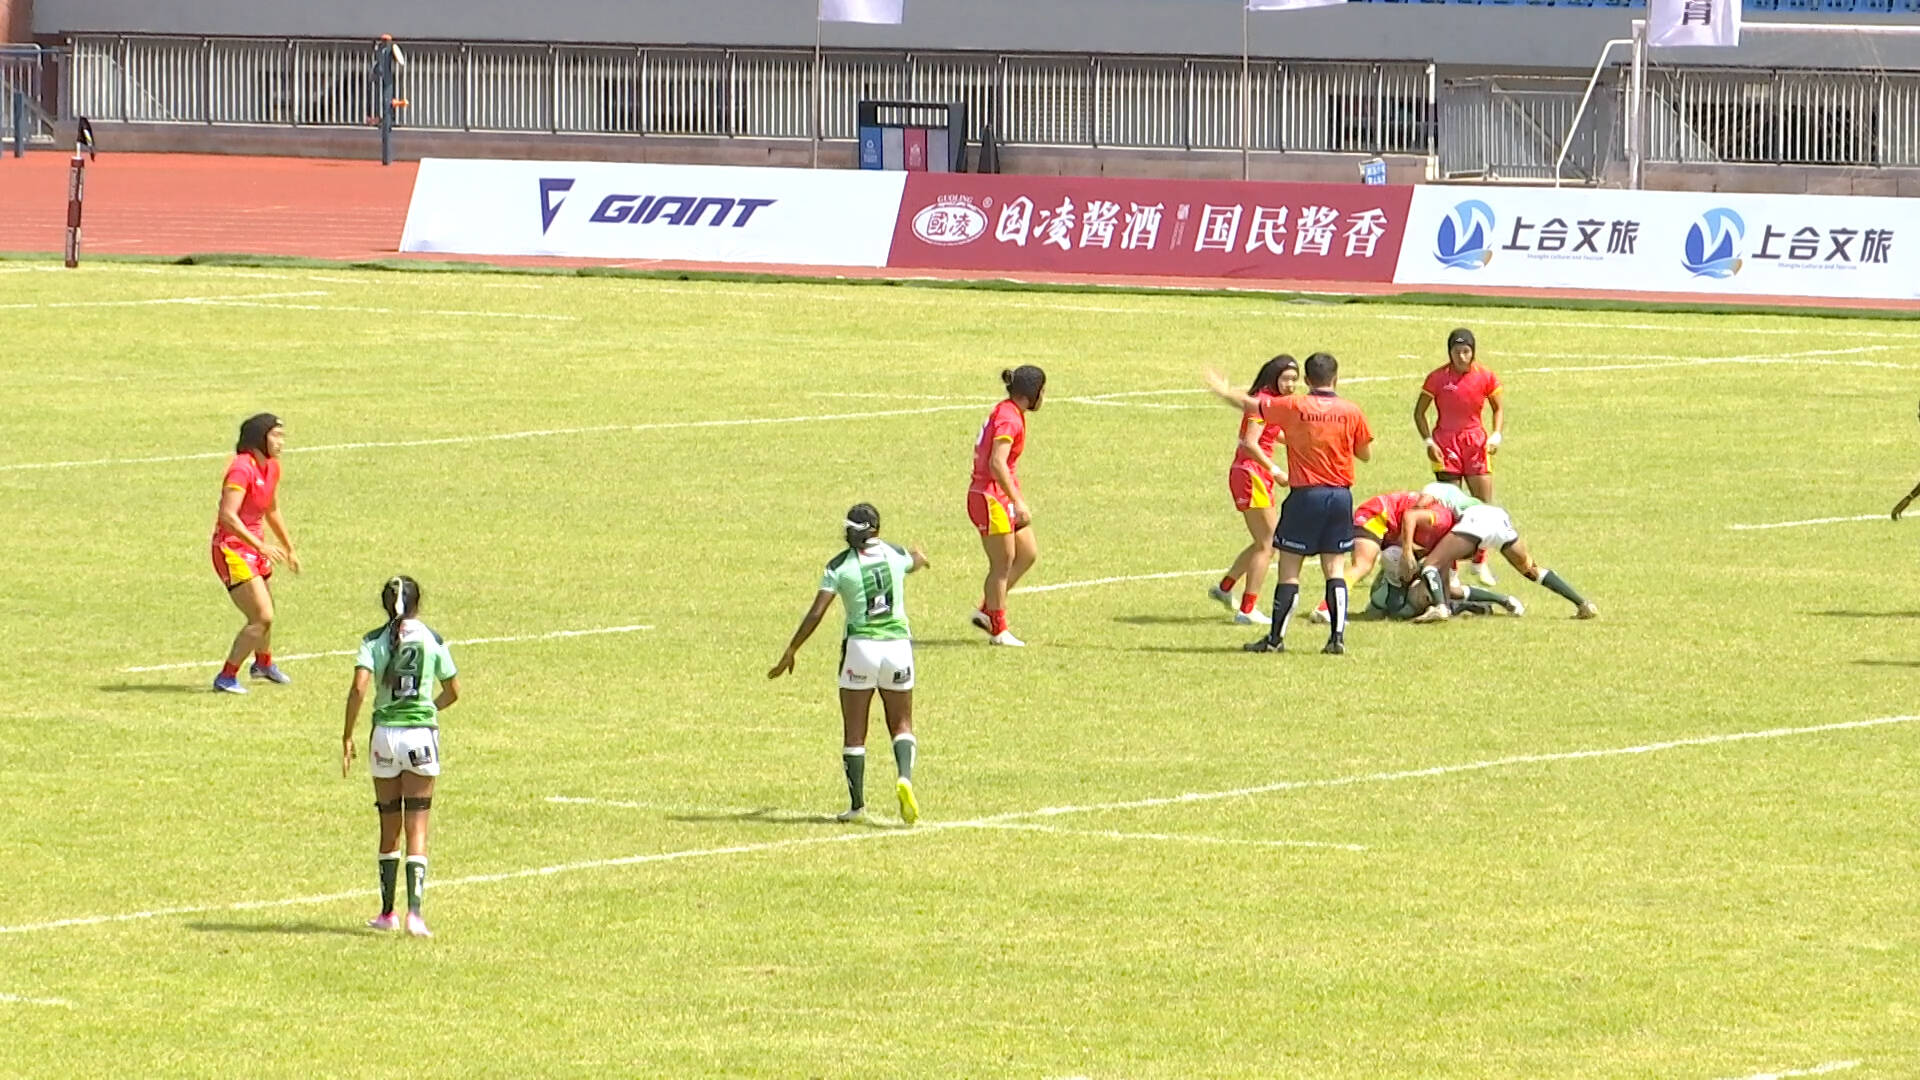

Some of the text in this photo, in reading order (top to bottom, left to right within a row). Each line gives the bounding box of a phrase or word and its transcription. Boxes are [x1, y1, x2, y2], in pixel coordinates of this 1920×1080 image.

[589, 194, 779, 227] GIANT
[1194, 203, 1388, 257] 国民酱香
[1501, 216, 1641, 254] 上合文旅
[1751, 224, 1895, 263] 上合文旅
[396, 646, 418, 671] 2
